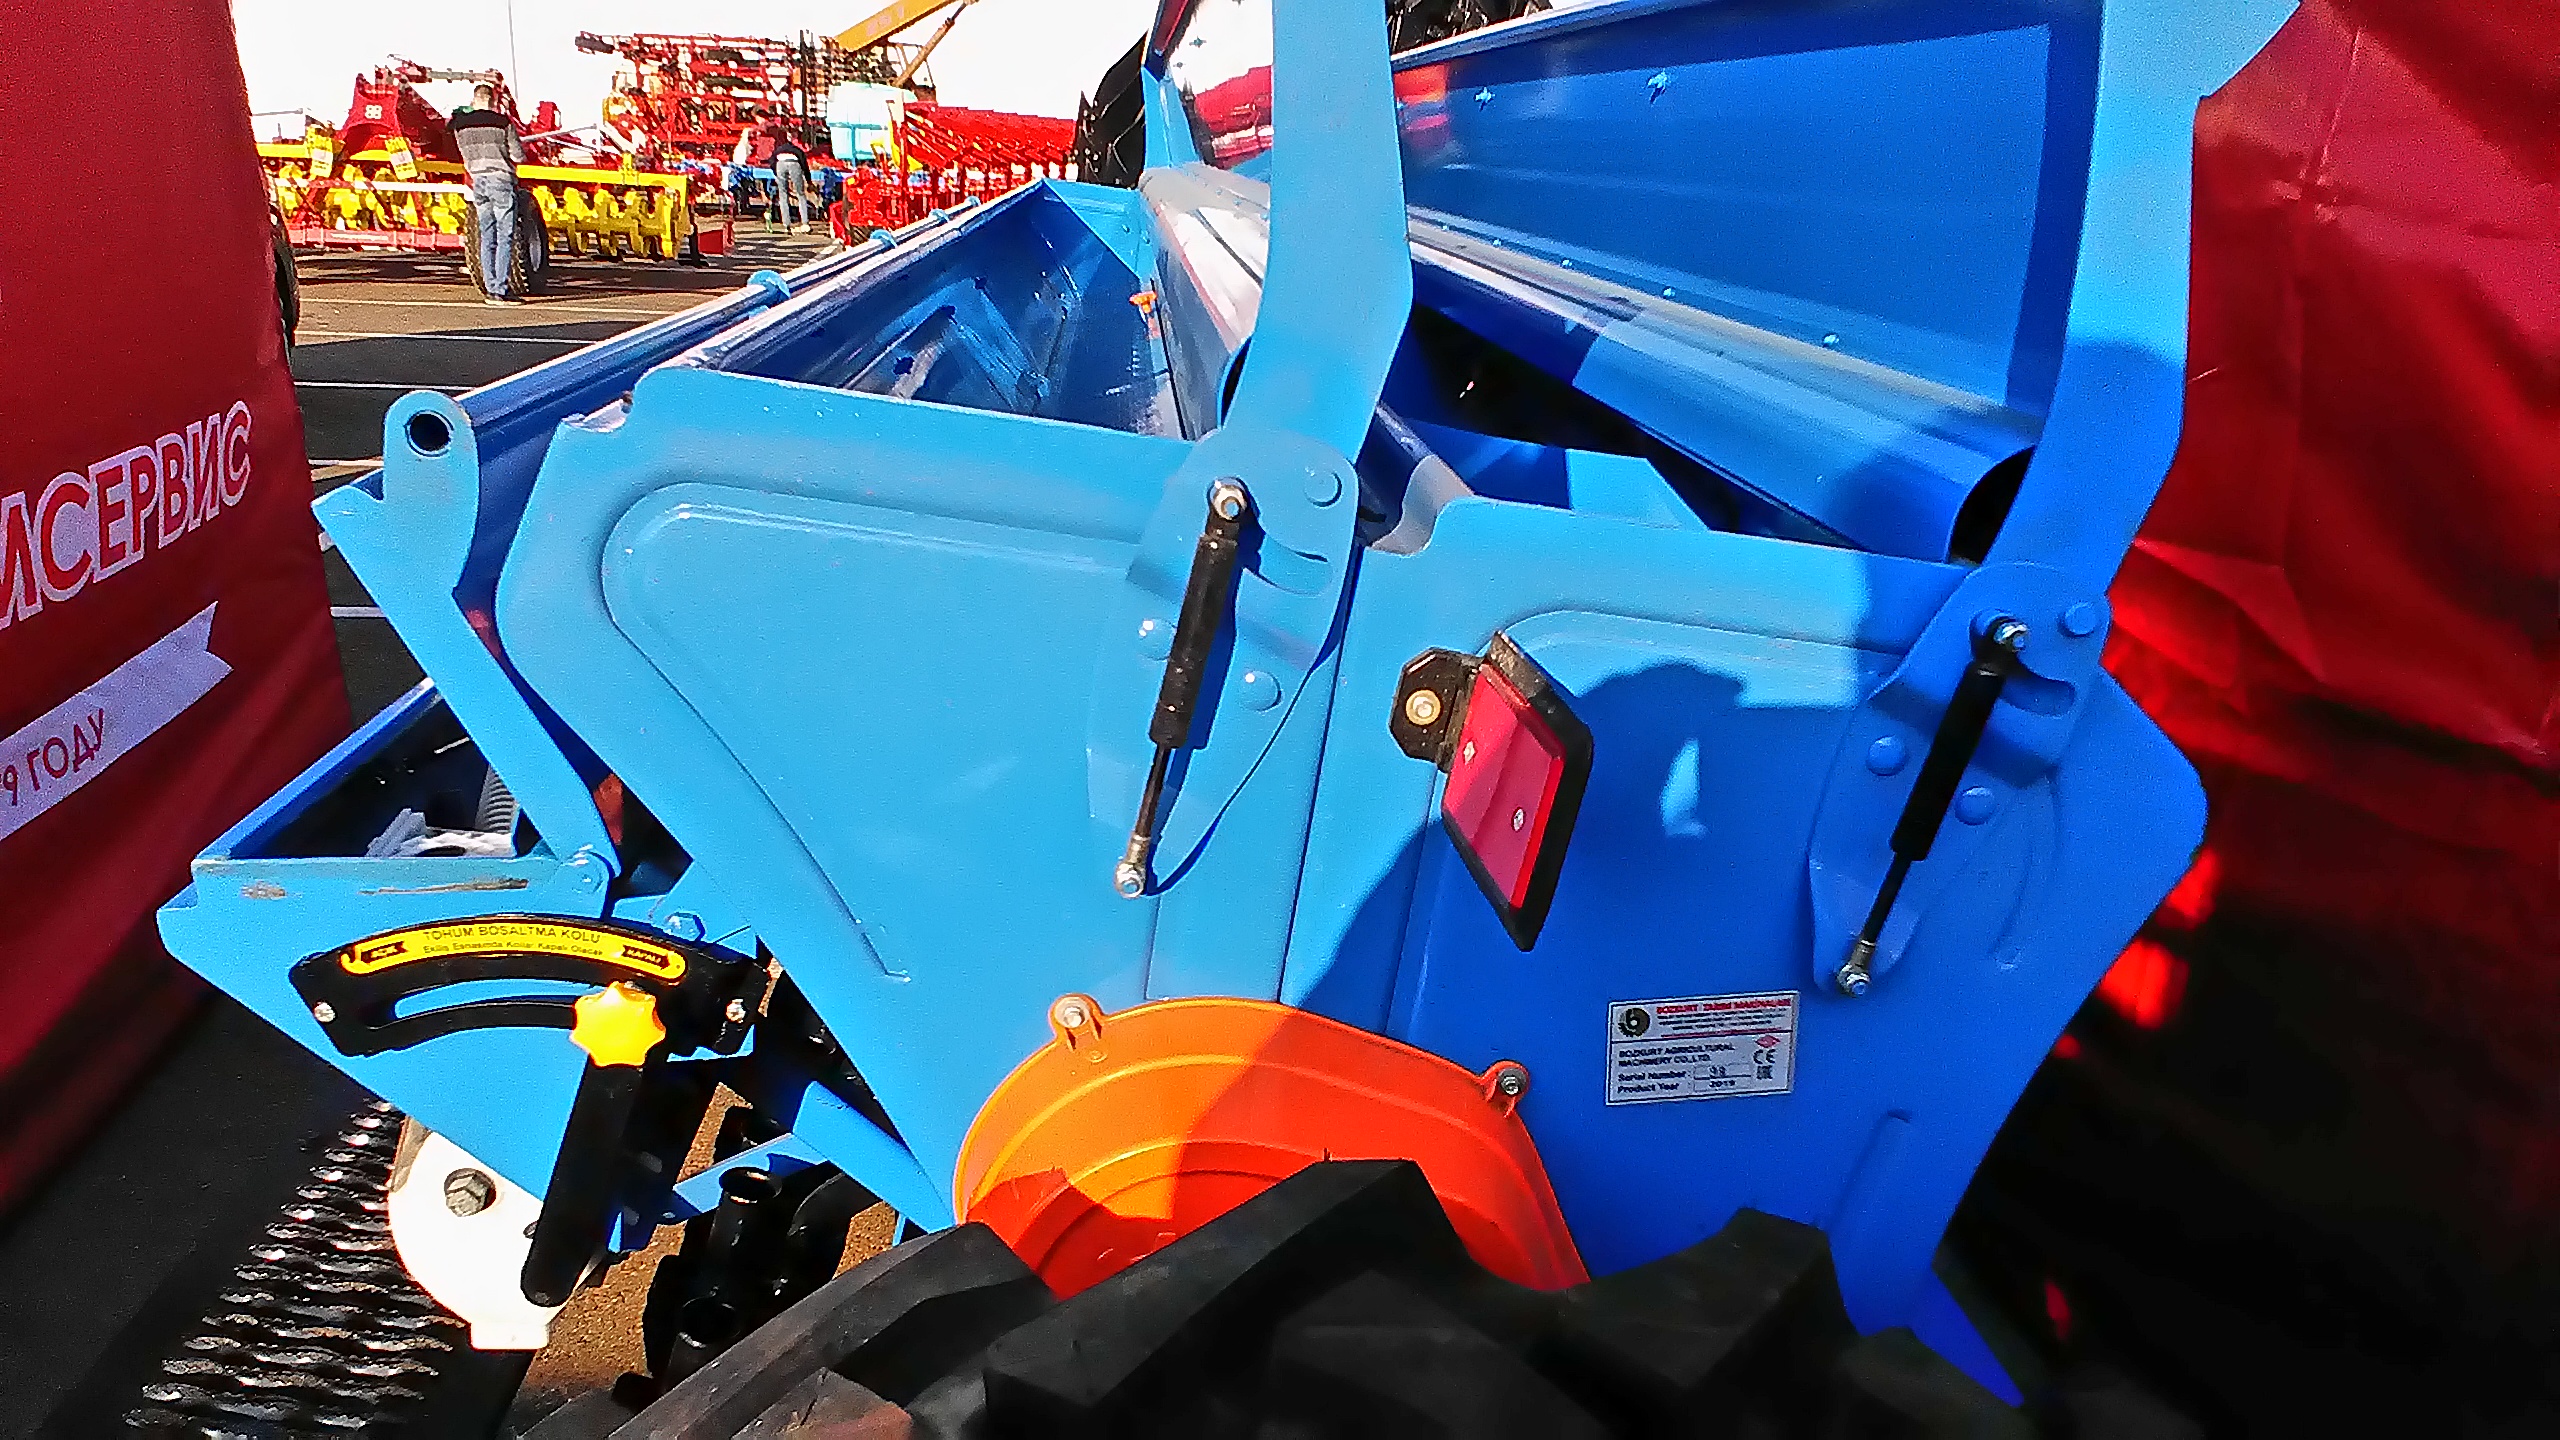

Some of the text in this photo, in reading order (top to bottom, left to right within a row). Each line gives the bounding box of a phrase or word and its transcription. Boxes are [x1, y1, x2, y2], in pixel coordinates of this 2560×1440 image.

[27, 708, 104, 791] ГОДУ
[423, 927, 474, 940] TOHUM
[561, 929, 601, 944] KOLU
[1619, 1047, 1663, 1058] BOZKURT
[1618, 1056, 1672, 1067] MACHINERY
[1618, 1072, 1646, 1082] Serial
[1648, 1070, 1686, 1080] Number
[1618, 1084, 1656, 1094] Product
[1659, 1082, 1679, 1091] Year
